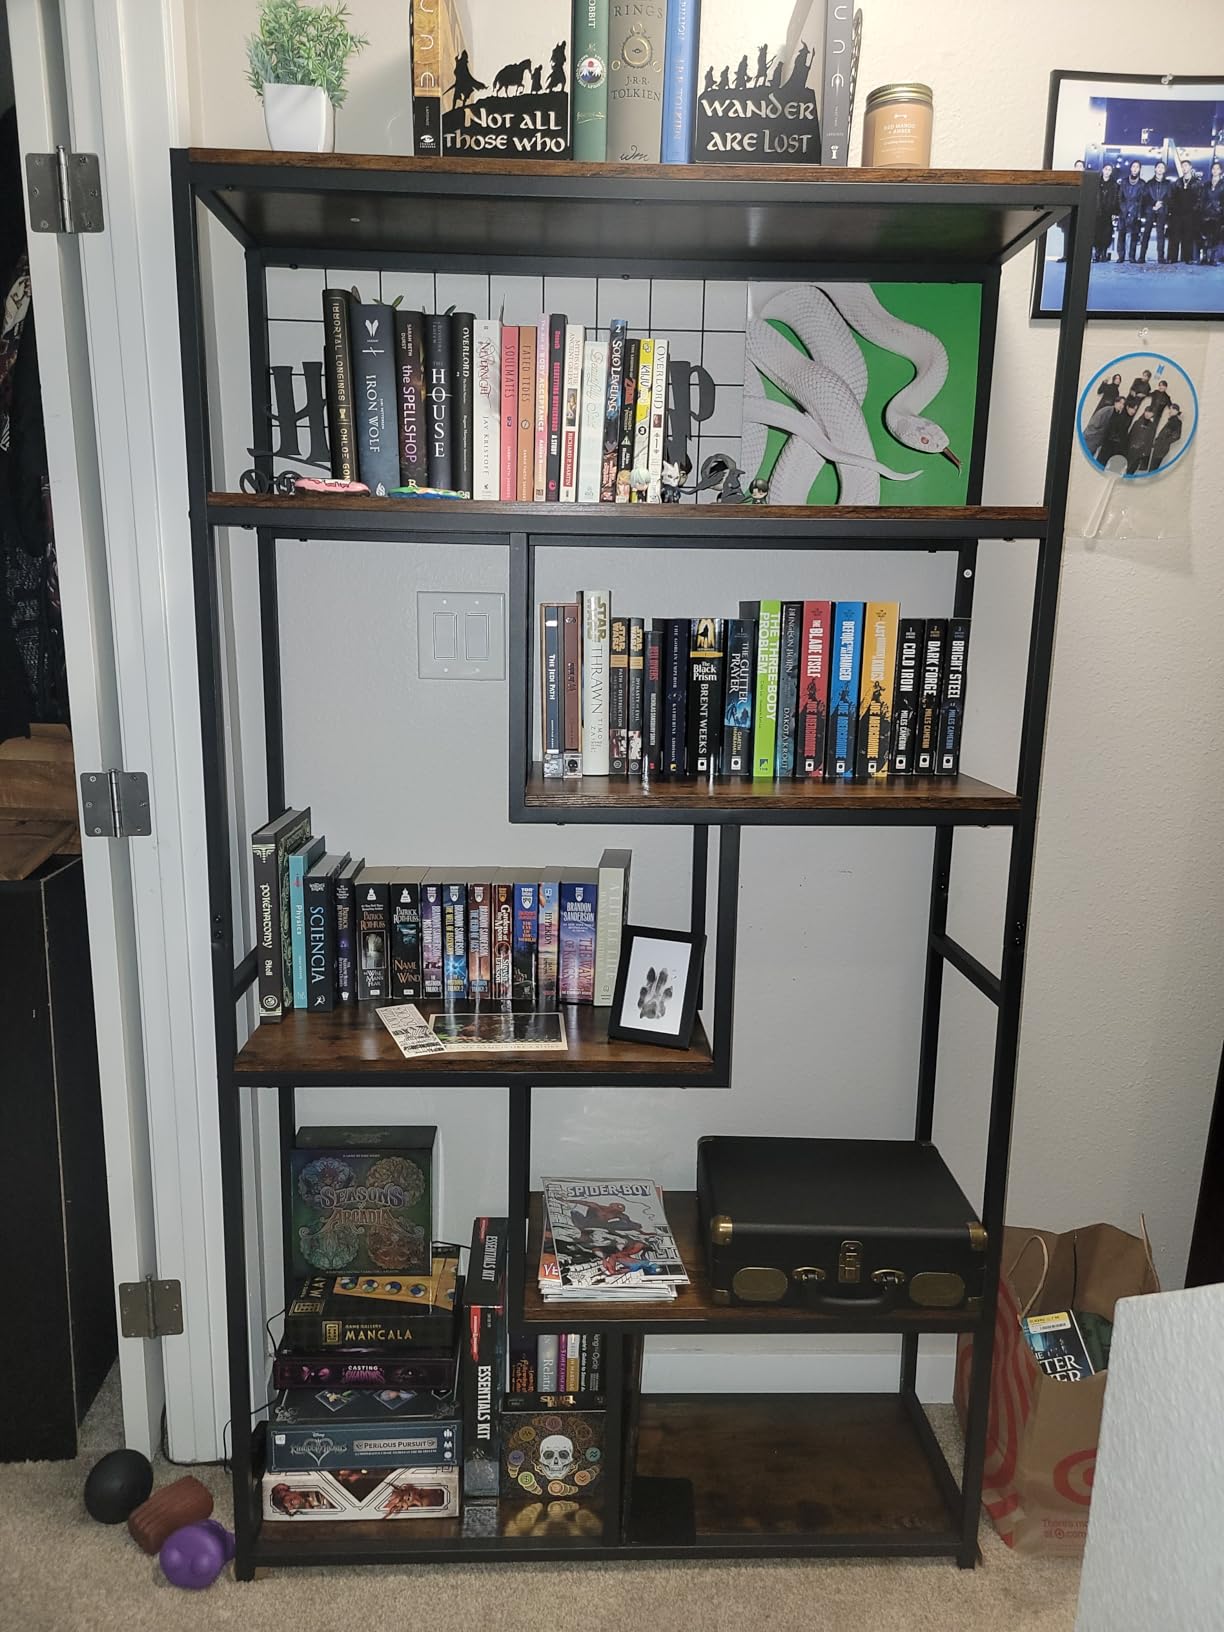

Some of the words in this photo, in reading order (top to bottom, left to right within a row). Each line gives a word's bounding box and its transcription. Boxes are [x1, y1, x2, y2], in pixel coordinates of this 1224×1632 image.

[614, 5, 664, 19] RINGS
[611, 88, 662, 102] TOLKIEN
[331, 302, 344, 351] IMMORTAL
[462, 327, 470, 378] OVERLORD
[521, 345, 533, 372] FATED
[610, 339, 623, 367] SOLO
[335, 354, 346, 401] LONGINGS
[401, 364, 413, 384] the
[504, 345, 515, 399] SOULMATES
[654, 345, 666, 409] OVERLORD
[365, 375, 379, 411] IRON
[522, 375, 534, 402] TIDES
[607, 367, 622, 412] LEVELING
[431, 368, 446, 458] HOUSE
[537, 377, 545, 433] ACCEPTANCE
[367, 412, 380, 453] WOLF
[403, 386, 418, 463] SPELLSHOP
[340, 428, 349, 459] CHLOE
[566, 432, 574, 457] RICHARD
[565, 463, 573, 486] MARTIN
[597, 598, 607, 642] STAR
[769, 611, 780, 637] THE
[841, 620, 855, 645] BEFORE
[618, 625, 626, 652] STAR
[741, 641, 749, 658] THE
[757, 611, 770, 674] PROBLEM
[808, 627, 823, 654] BLADE
[548, 654, 556, 667] THE
[902, 642, 916, 666] COLD
[926, 640, 941, 665] DARK
[950, 640, 965, 672] BRIGHT
[548, 668, 556, 683] JEDI
[590, 644, 603, 714] THRAWN
[649, 660, 658, 681] DIVERS
[693, 663, 717, 674] Black
[693, 672, 717, 682] Prism
[728, 653, 741, 694] PRAYER
[806, 655, 822, 678] ITSELF
[839, 653, 852, 681] HANGED
[870, 656, 885, 681] KINGS
[548, 684, 556, 700] PATH
[737, 658, 750, 705] GUTTER
[766, 640, 778, 721] THREE-BODY
[899, 668, 914, 692] IRON
[923, 666, 939, 697] FORGE
[947, 673, 962, 699] STEEL
[699, 683, 709, 717] BRENT
[806, 699, 817, 713] JOE
[838, 700, 849, 715] JOE
[870, 700, 881, 715] JOE
[782, 707, 790, 740] DAKOTA
[900, 709, 908, 726] MILES
[924, 708, 932, 724] MILES
[947, 709, 956, 725] MILES
[698, 719, 708, 754] WEEKS
[804, 714, 817, 757] ABERCROMBIE
[835, 716, 848, 759] ABERCROMBIE
[867, 716, 881, 759] ABERCROMBIE
[898, 726, 907, 751] CAMERON
[922, 724, 932, 749] CAMERON
[946, 725, 955, 750] CAMERON
[781, 741, 789, 770] KROUT
[294, 904, 304, 935] Physics
[363, 912, 384, 921] PATRICK
[393, 914, 420, 924] ROTHFUSS
[395, 906, 417, 916] PATRICK
[431, 905, 441, 928] BRANDON
[454, 904, 464, 927] BRANDON
[479, 905, 488, 928] BRANDON
[501, 904, 511, 934] Gardens
[563, 911, 595, 922] SANDERSON
[566, 902, 592, 912] BRANDON
[360, 920, 386, 931] ROTHFUSS
[470, 919, 479, 932] HERO
[494, 919, 503, 942] Moon
[544, 912, 553, 945] HYPERION
[309, 906, 326, 984] SCIENCIA
[431, 928, 442, 958] SANDERSON
[454, 927, 464, 956] SANDERSON
[479, 928, 489, 957] SANDERSON
[565, 939, 574, 949] OF
[579, 937, 593, 957] THE
[394, 960, 417, 971] NAME
[501, 959, 510, 982] Steven
[562, 950, 577, 979] KINGS
[579, 958, 592, 979] WAY
[397, 973, 421, 984] WIND
[320, 1182, 405, 1209] SEASONS
[566, 1184, 651, 1197] SPIDER-BOY
[331, 1208, 394, 1226] ARCADIA
[482, 1235, 498, 1268] ESSENTIALS
[481, 1269, 495, 1282] KIT
[345, 1329, 412, 1341] MANCALA
[591, 1352, 600, 1369] Cycle
[1039, 1354, 1083, 1374] TER
[477, 1365, 492, 1421] ESSENTIALS
[477, 1423, 490, 1440] KIT
[363, 1441, 397, 1449] PERILOUS
[397, 1440, 427, 1448] PURSUIT
